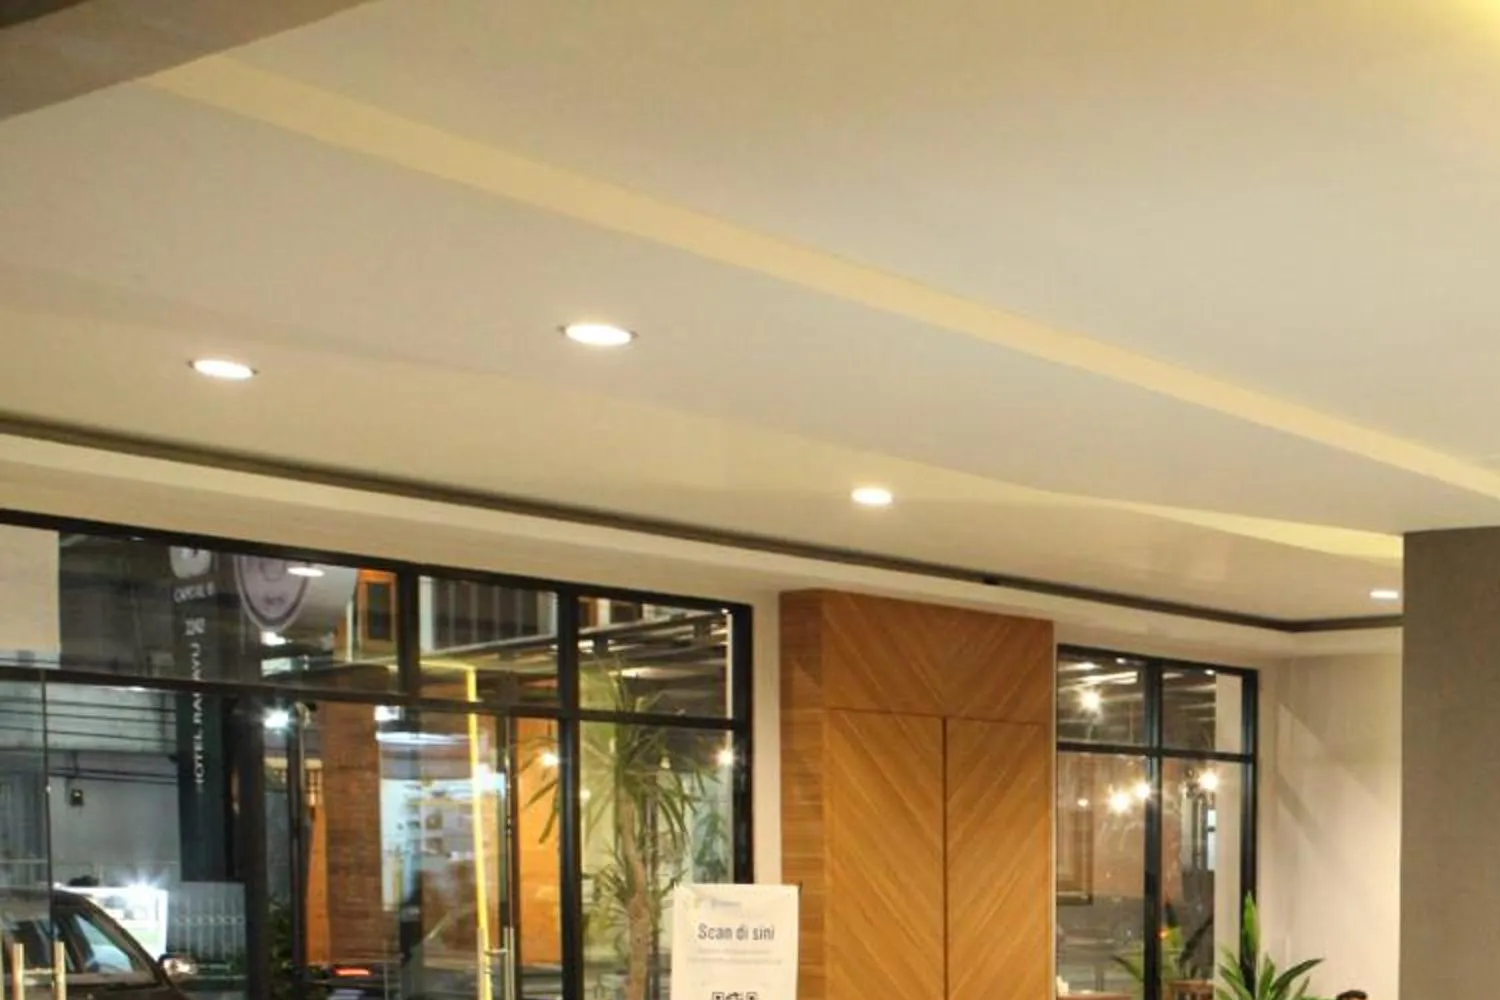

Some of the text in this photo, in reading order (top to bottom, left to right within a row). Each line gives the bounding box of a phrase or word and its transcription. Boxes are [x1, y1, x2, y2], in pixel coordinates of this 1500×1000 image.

[697, 922, 775, 941] Scan di sini
